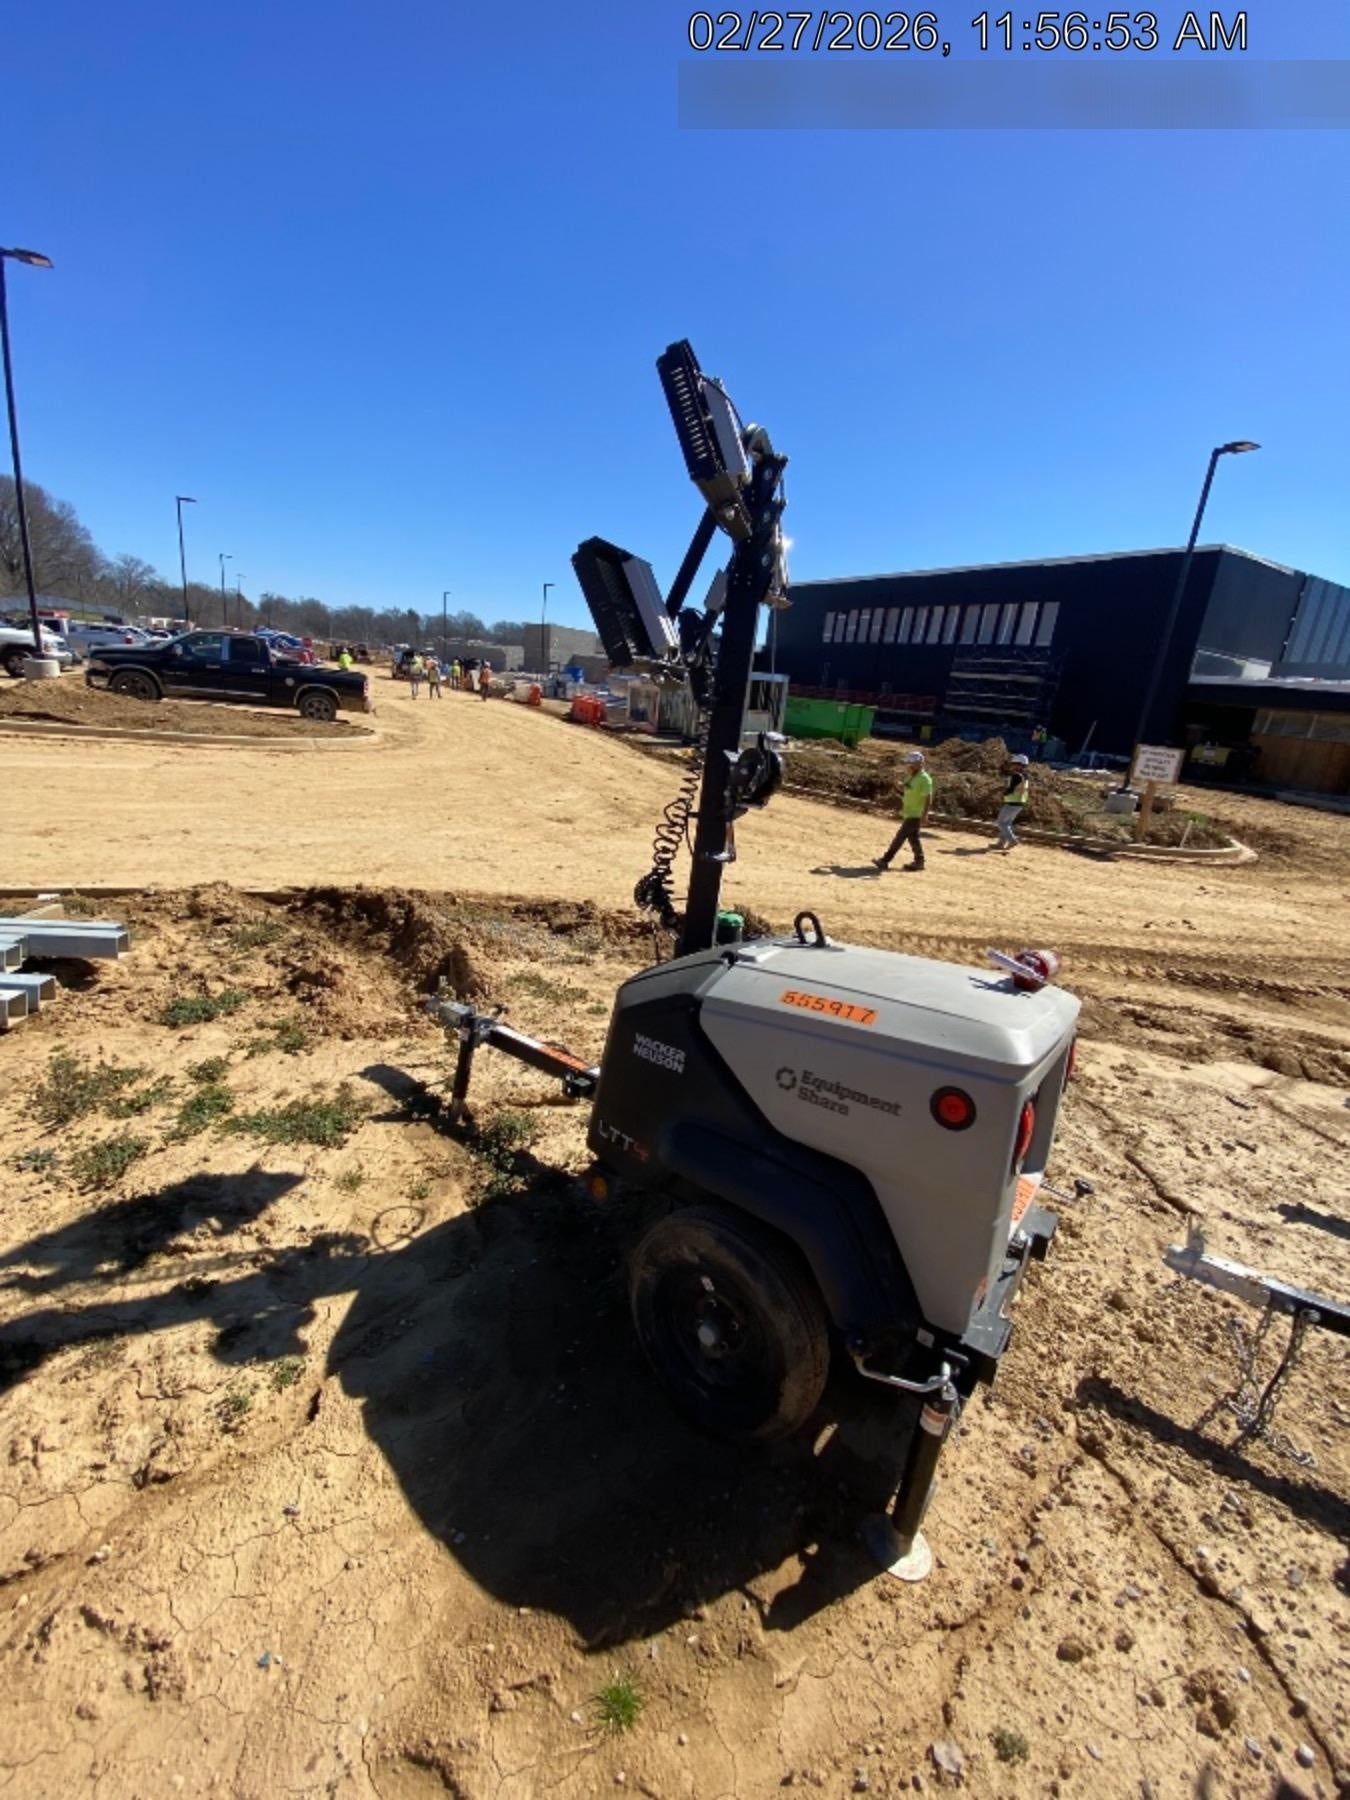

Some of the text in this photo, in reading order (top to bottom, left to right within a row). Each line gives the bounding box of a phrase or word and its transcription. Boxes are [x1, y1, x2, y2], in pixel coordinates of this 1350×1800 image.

[633, 1043, 685, 1073] NEUSON
[634, 1032, 686, 1063] WACKER
[798, 1085, 849, 1116] Share
[801, 1069, 902, 1116] Equipment
